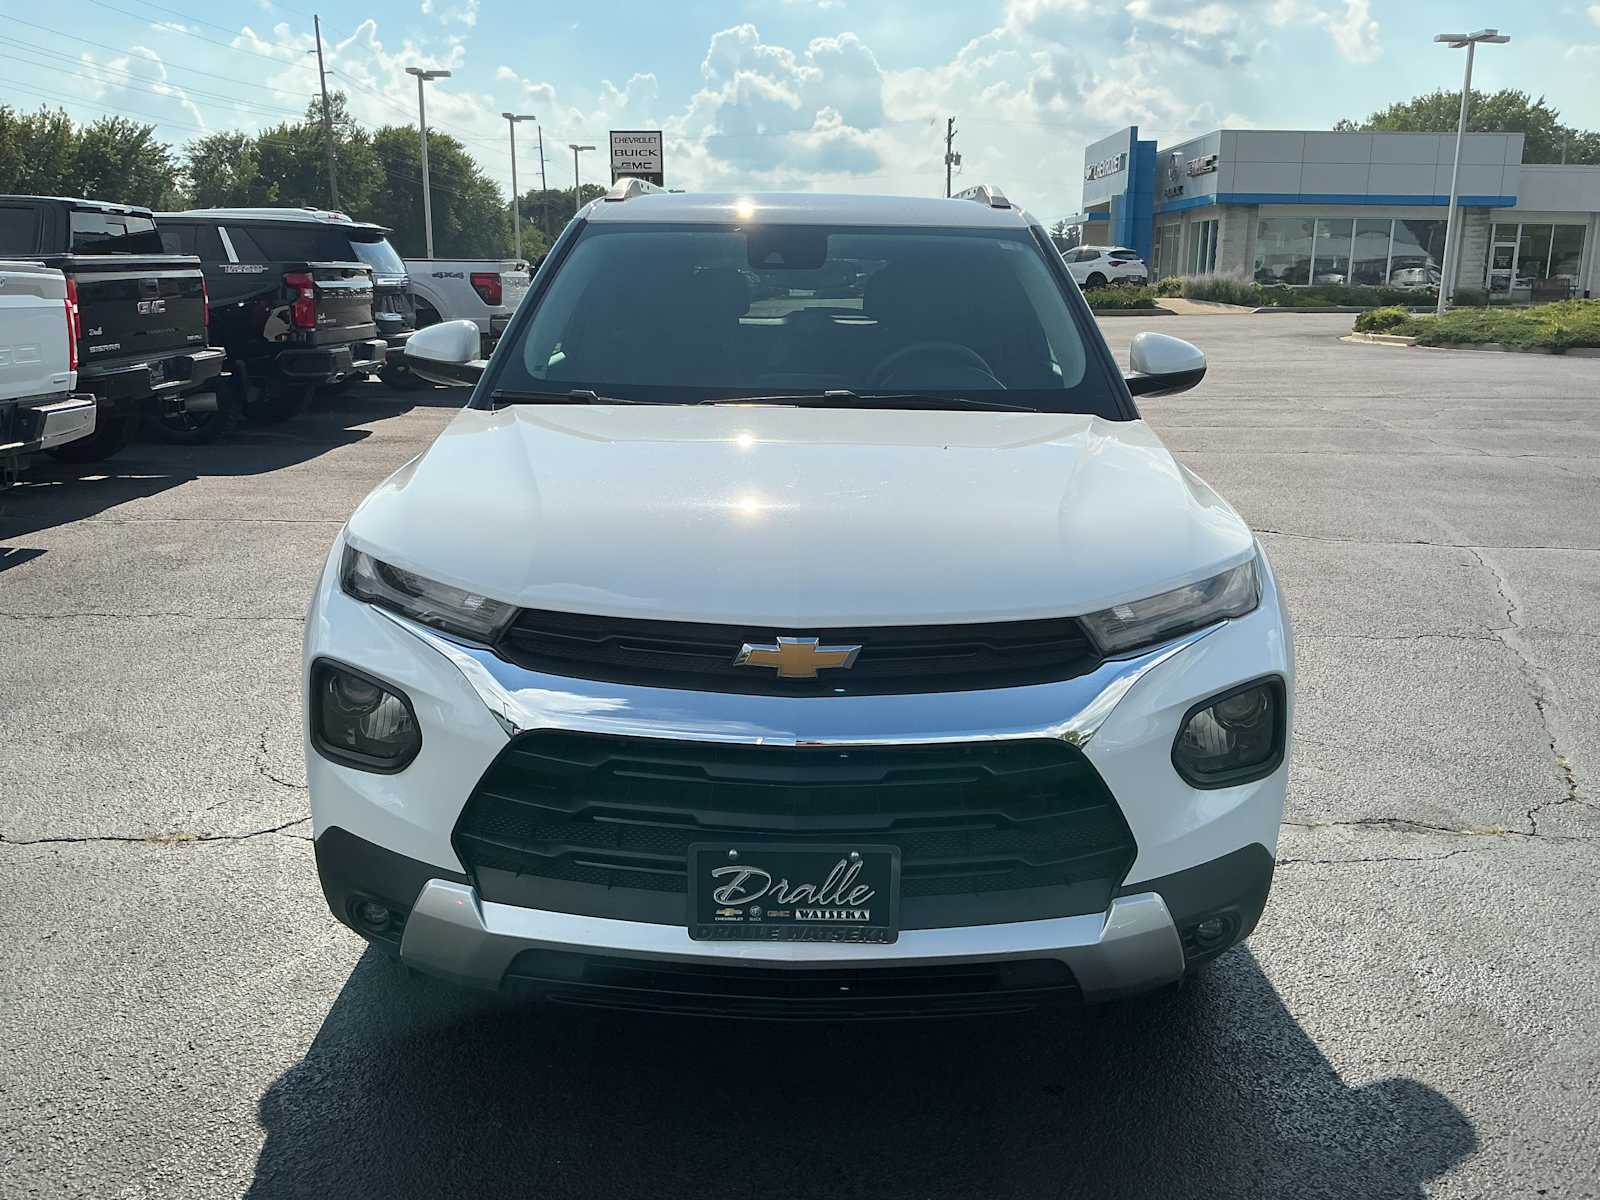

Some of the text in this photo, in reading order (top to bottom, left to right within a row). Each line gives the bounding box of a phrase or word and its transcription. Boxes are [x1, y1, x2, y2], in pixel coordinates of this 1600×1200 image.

[614, 136, 657, 144] CHEVROLET
[614, 149, 658, 157] BUICK
[621, 161, 653, 170] GMC
[711, 858, 876, 906] Dralle
[798, 909, 869, 920] WATSEKA
